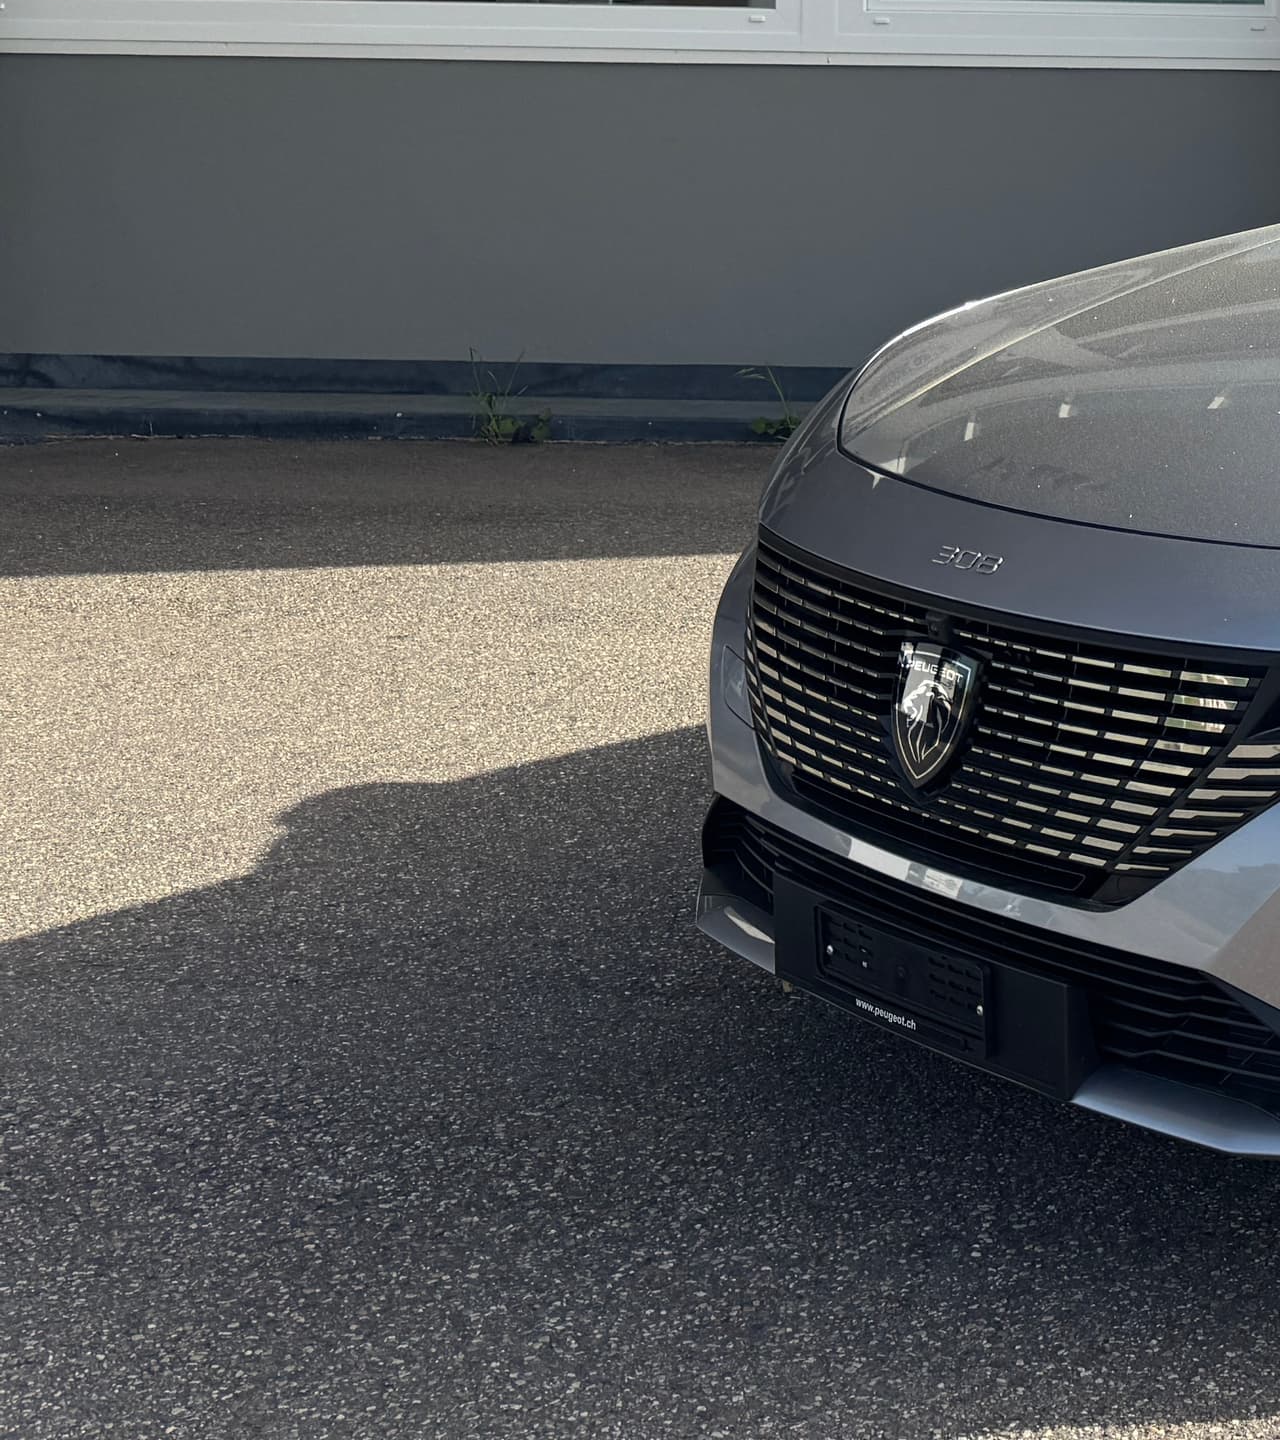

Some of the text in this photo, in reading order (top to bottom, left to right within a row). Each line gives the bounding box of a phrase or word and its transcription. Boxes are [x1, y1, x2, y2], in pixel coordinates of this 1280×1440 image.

[932, 545, 1003, 575] 308
[909, 659, 963, 683] PEUGEOT
[855, 998, 917, 1030] www.peugeot.ch
